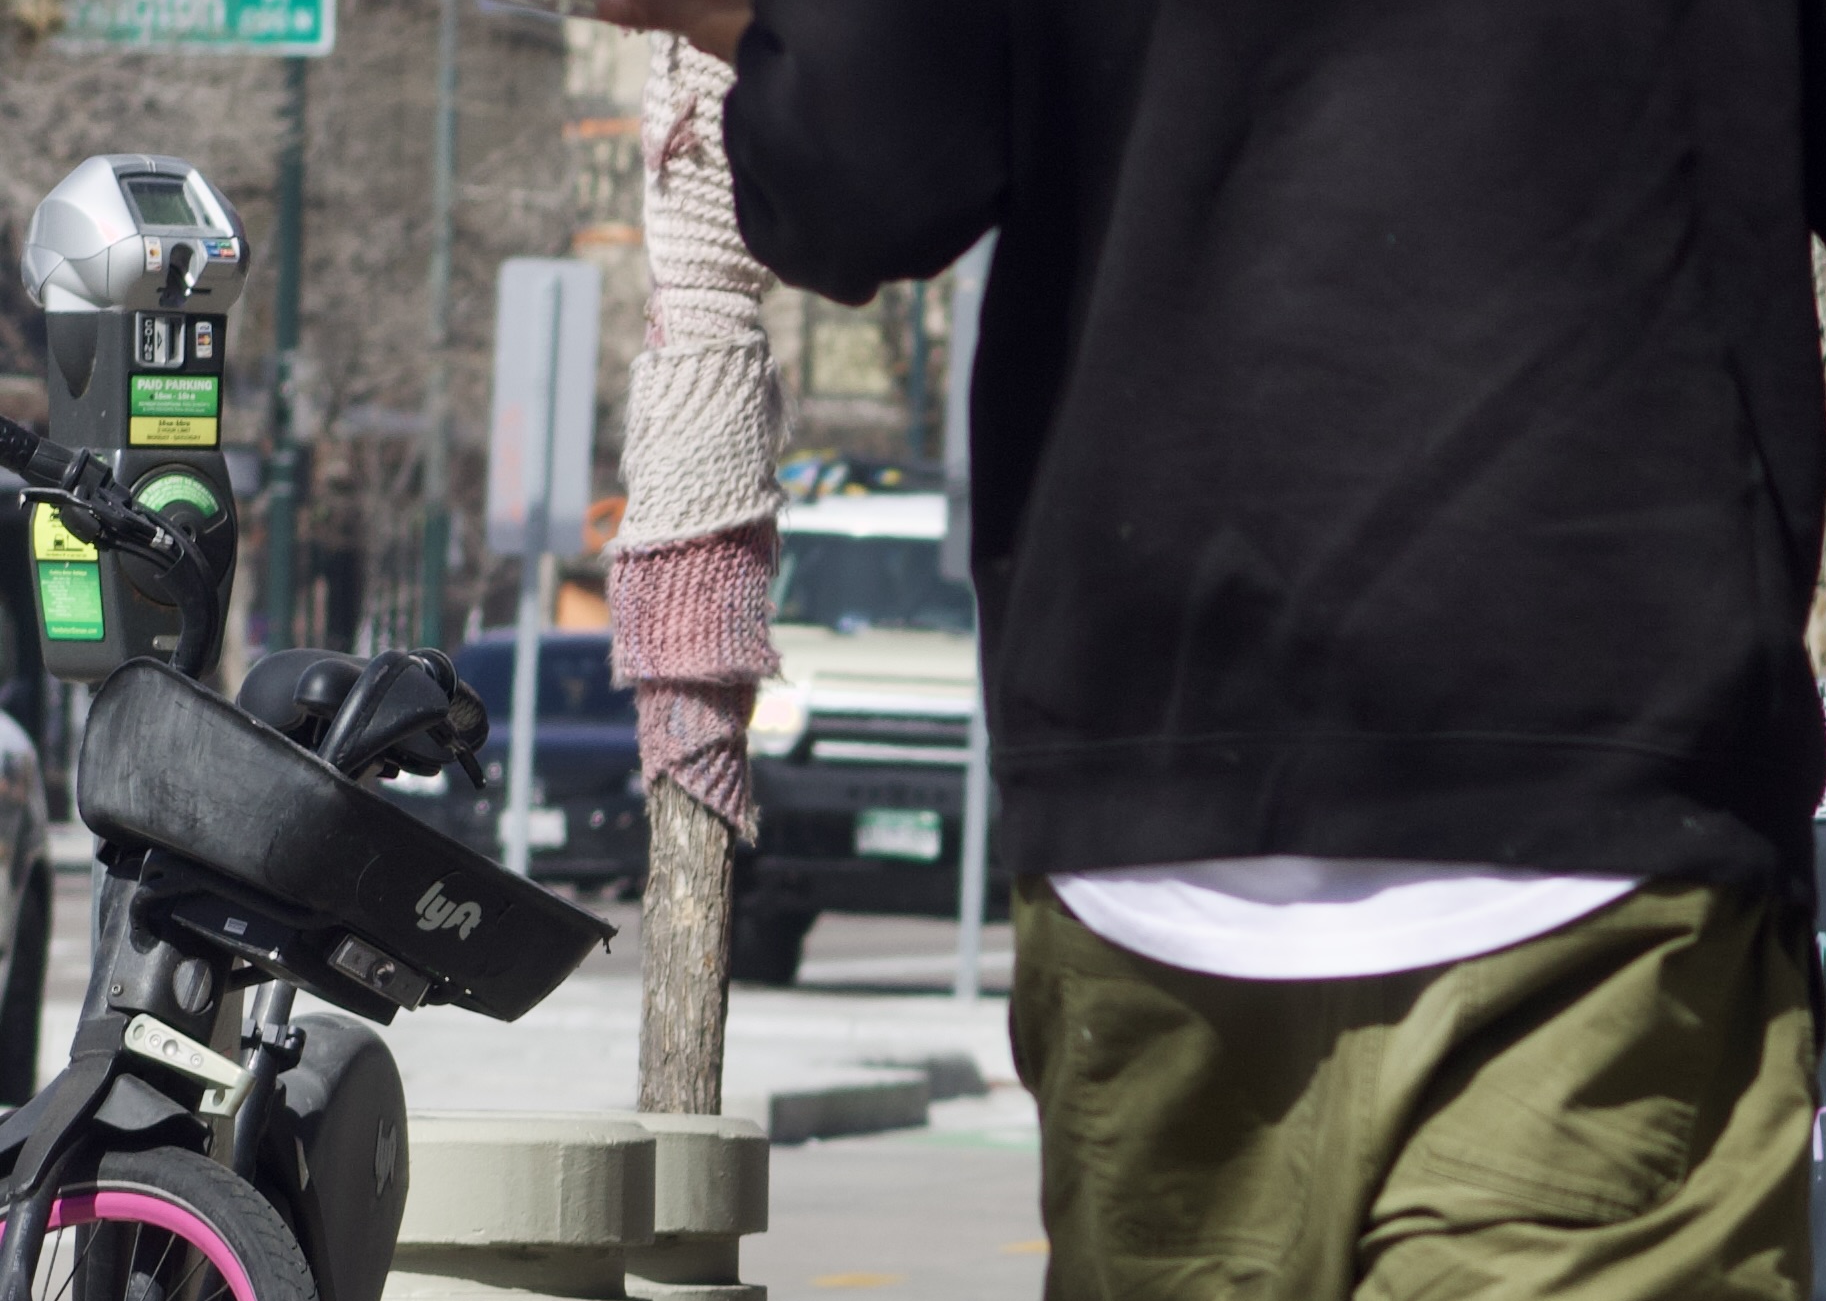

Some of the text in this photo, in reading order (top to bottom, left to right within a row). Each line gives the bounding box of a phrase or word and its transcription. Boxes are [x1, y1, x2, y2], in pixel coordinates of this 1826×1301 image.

[144, 319, 153, 360] COINS
[137, 379, 213, 391] PAID PARKING
[415, 880, 482, 941] lyft
